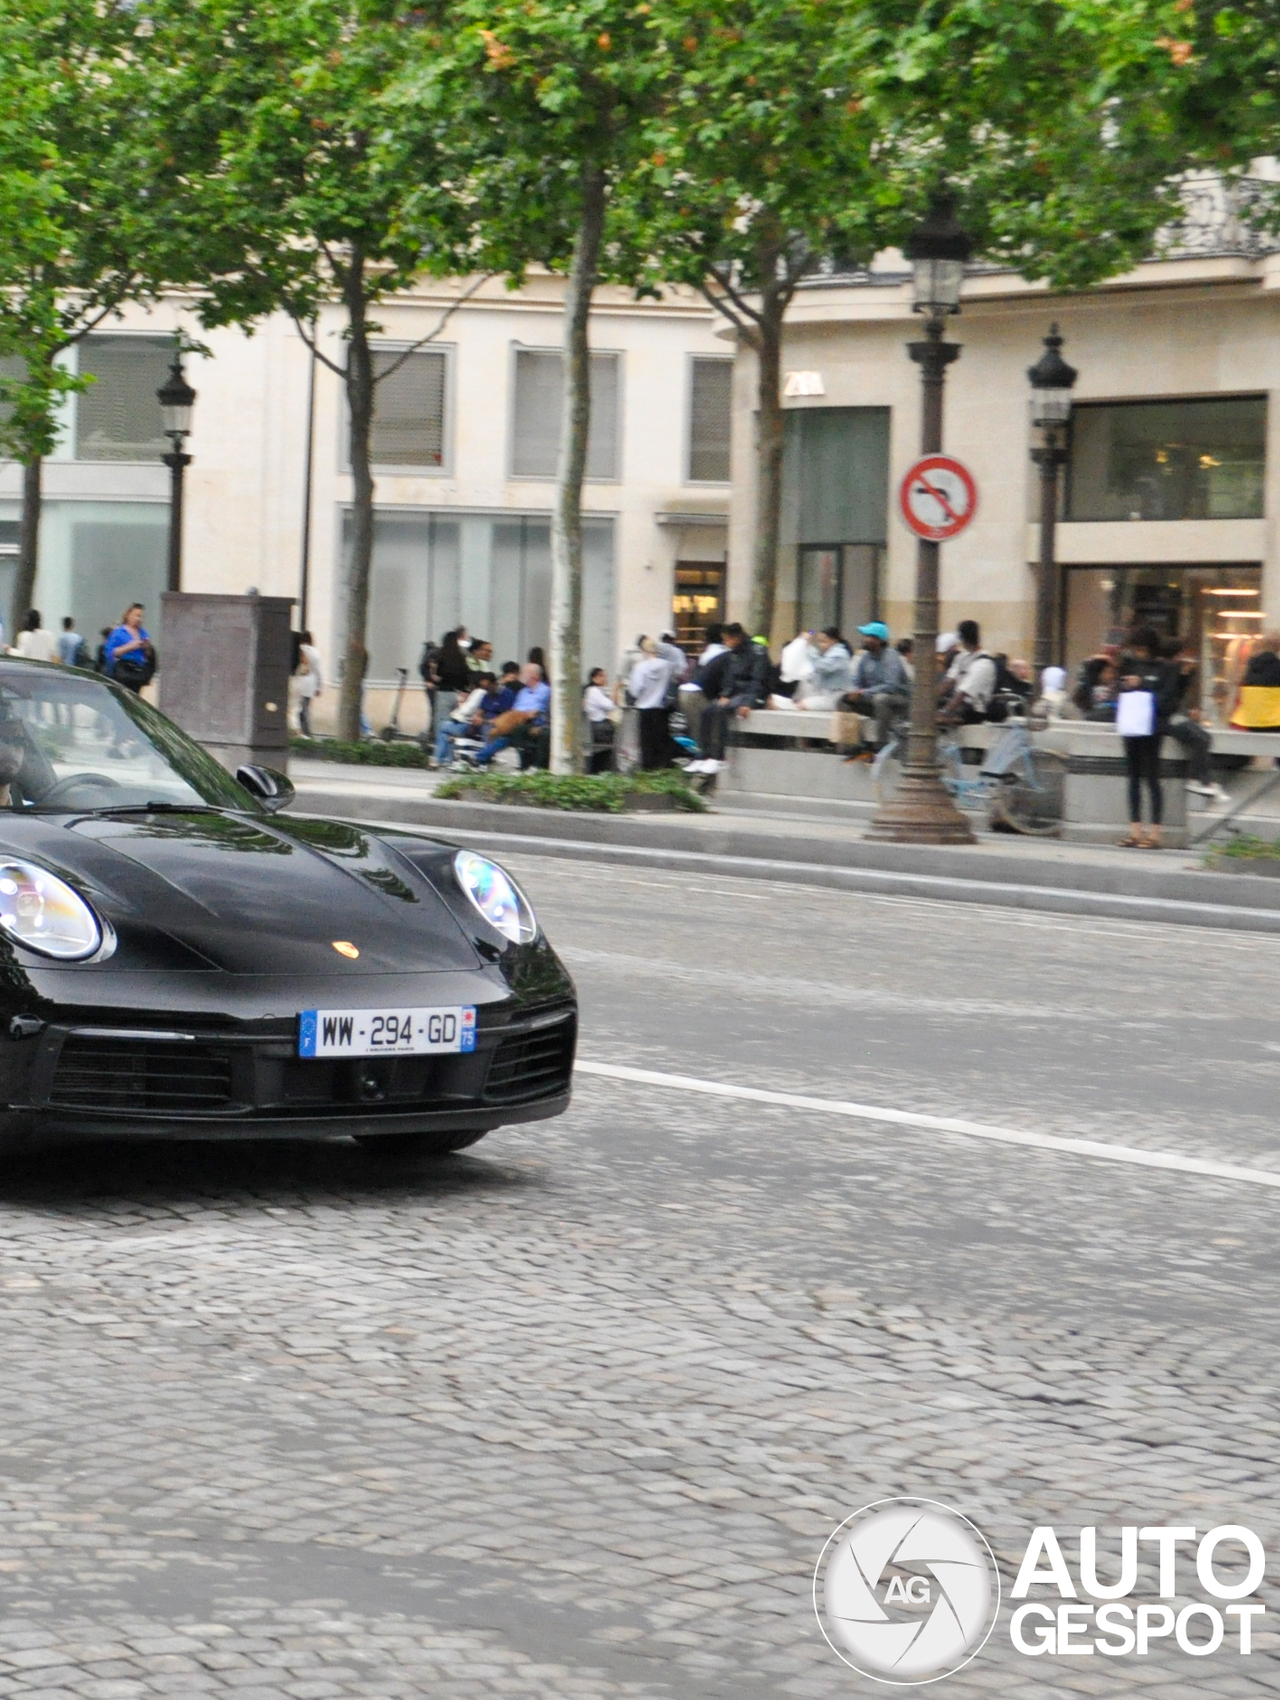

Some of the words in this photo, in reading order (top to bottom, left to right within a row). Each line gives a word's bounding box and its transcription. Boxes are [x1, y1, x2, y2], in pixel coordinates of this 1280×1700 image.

[323, 1014, 457, 1046] WW-294-GD
[305, 1037, 311, 1047] F
[462, 1031, 474, 1045] 75
